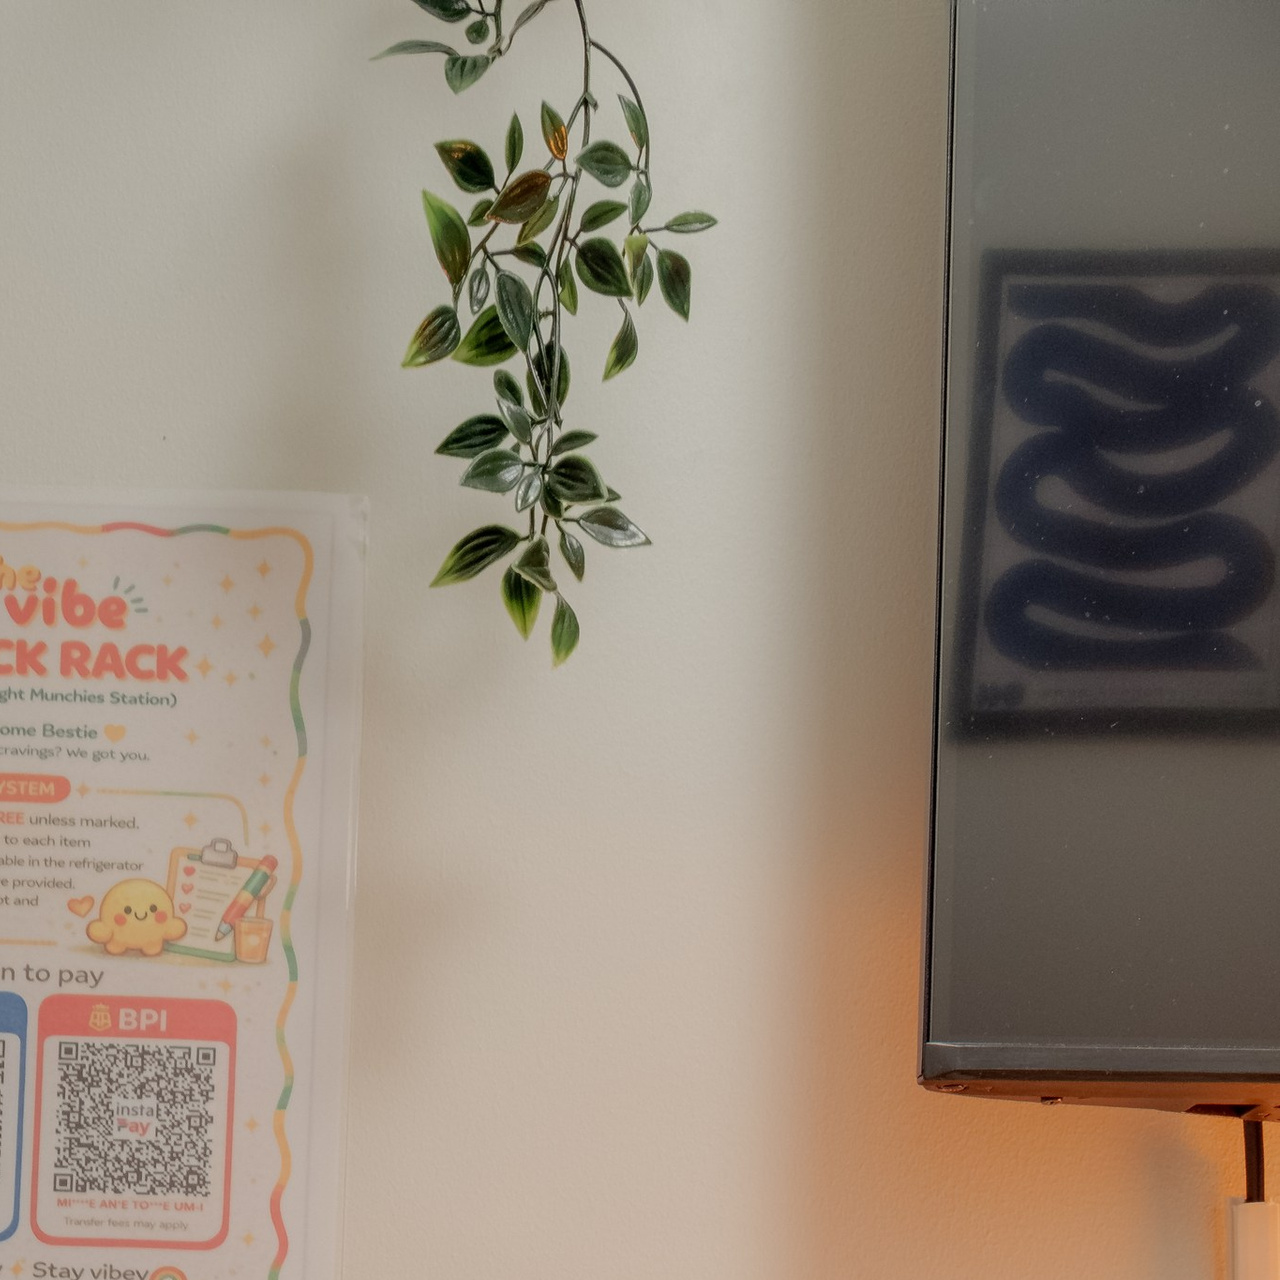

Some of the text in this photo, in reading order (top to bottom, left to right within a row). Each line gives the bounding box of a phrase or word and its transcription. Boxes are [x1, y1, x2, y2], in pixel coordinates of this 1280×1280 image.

[4, 577, 127, 630] vibe
[60, 639, 189, 682] RACK
[30, 689, 105, 704] Munchies
[109, 691, 177, 708] Station)
[42, 724, 98, 740] Bestie
[66, 748, 89, 760] We
[92, 750, 115, 763] got
[119, 752, 150, 764] you.
[29, 812, 76, 827] unless
[80, 815, 139, 830] marked.
[3, 833, 17, 846] to
[22, 833, 55, 847] each
[60, 835, 92, 848] item
[28, 855, 40, 868] in
[44, 856, 65, 870] the
[69, 856, 144, 875] refrigerator
[12, 874, 75, 891] provided.
[14, 895, 39, 908] and
[24, 963, 50, 984] to
[58, 969, 105, 989] pay
[118, 1009, 168, 1032] BPI
[64, 1217, 188, 1230] Transfer fees may apply
